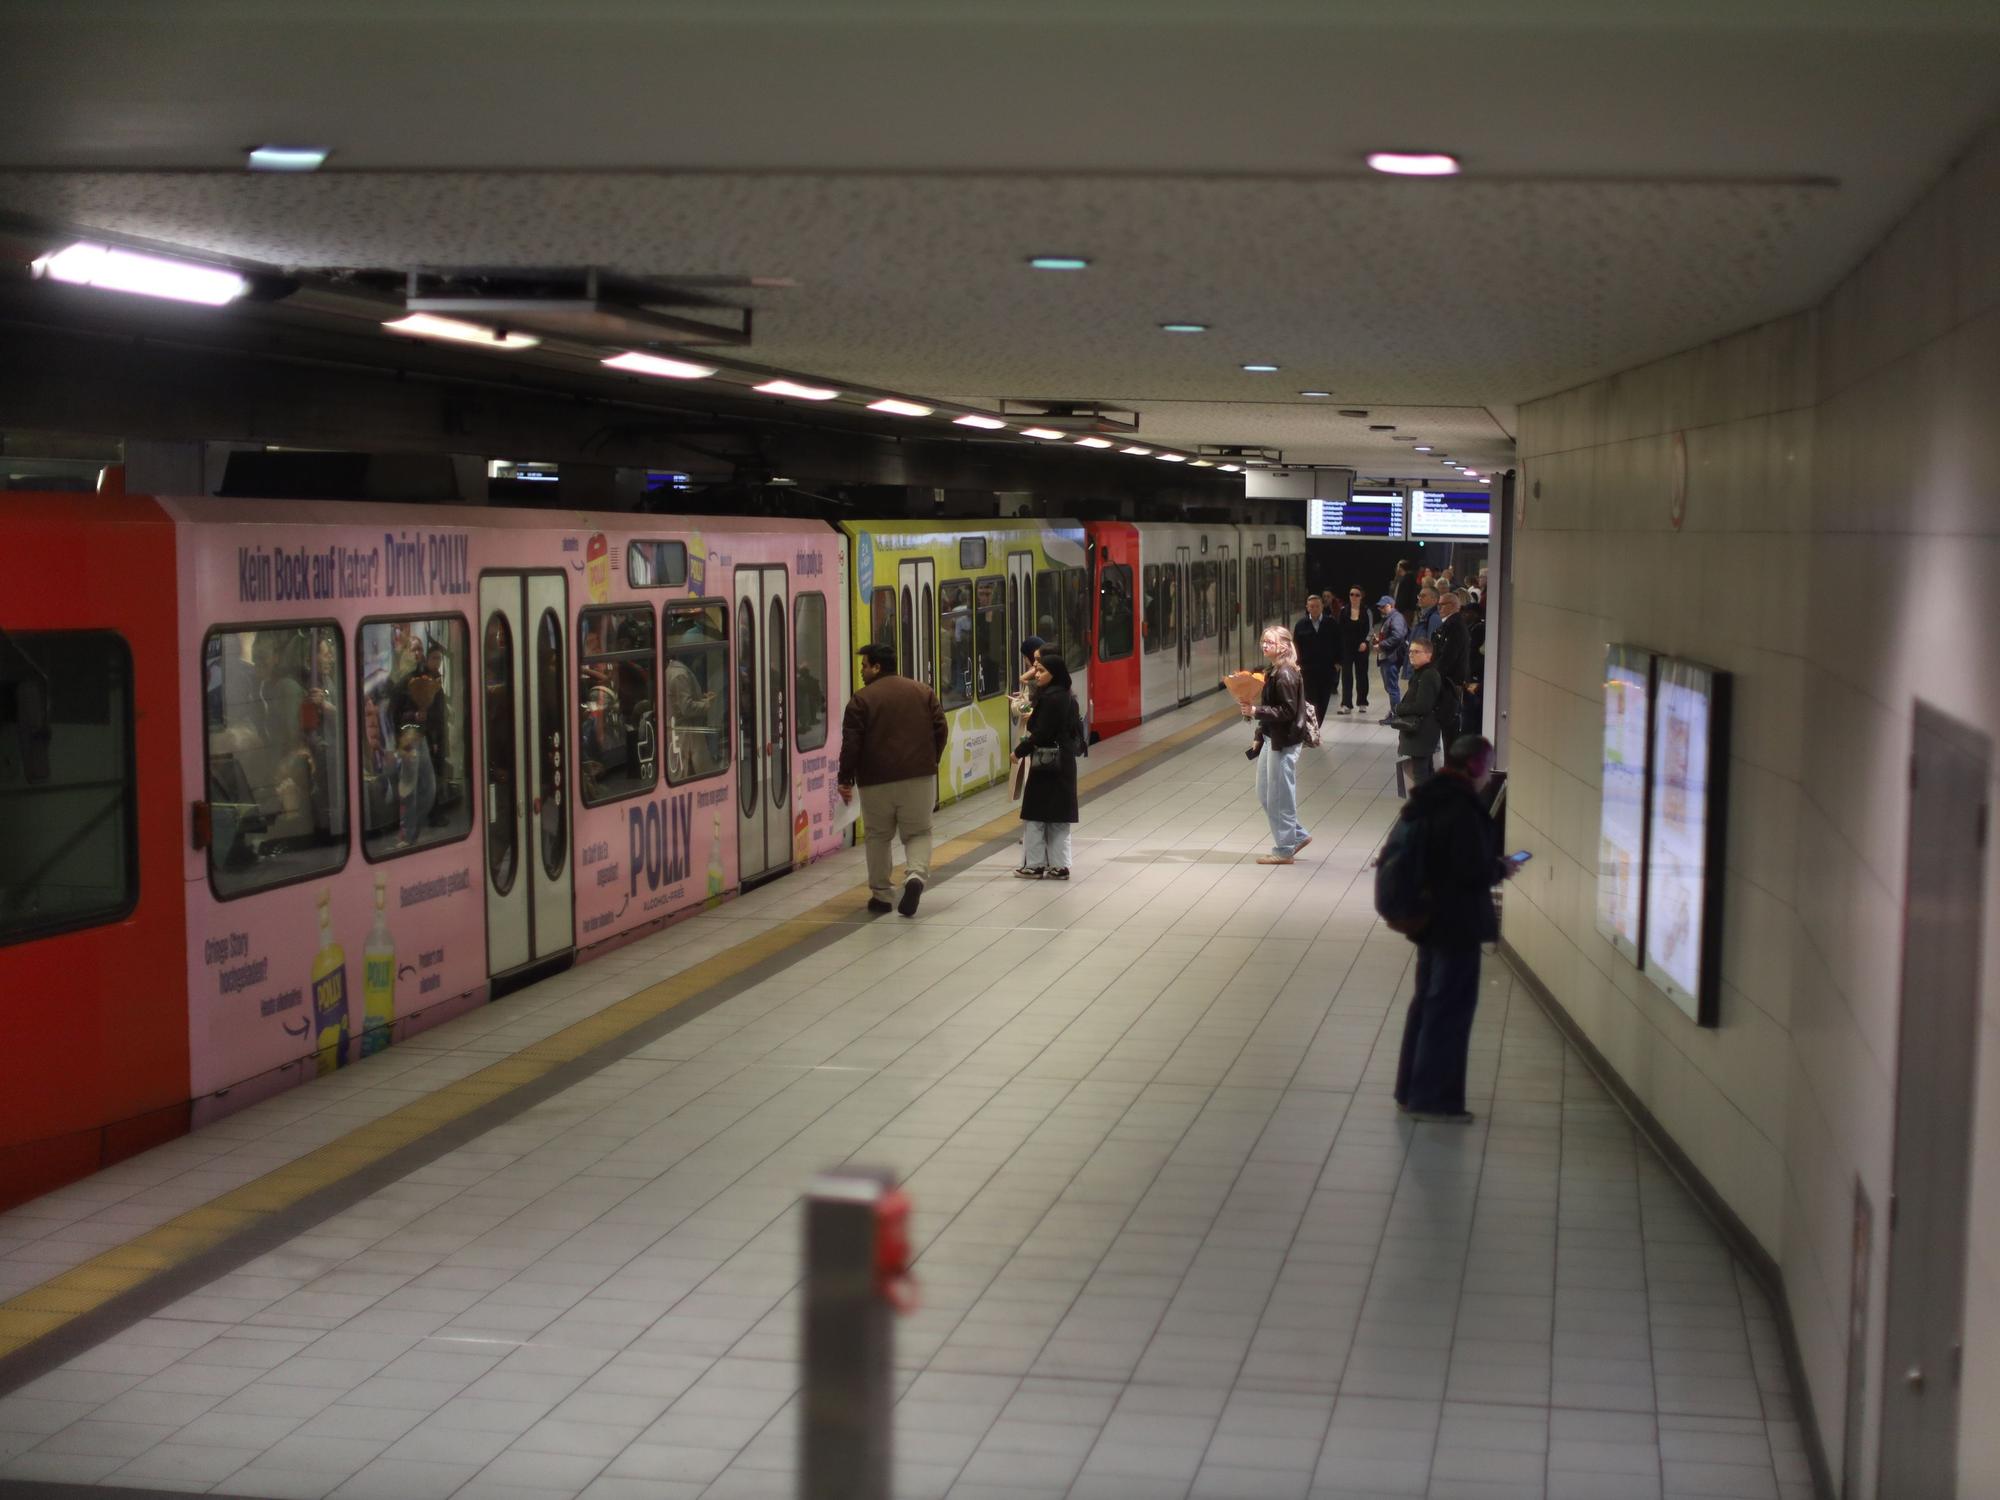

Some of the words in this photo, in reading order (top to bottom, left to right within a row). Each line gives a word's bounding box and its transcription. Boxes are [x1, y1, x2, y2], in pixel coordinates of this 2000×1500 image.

[239, 546, 271, 602] Kein
[274, 546, 310, 601] Bock
[313, 546, 335, 600] auf
[338, 547, 379, 599] Kater?
[384, 532, 426, 597] Drink
[629, 791, 692, 897] POLLY
